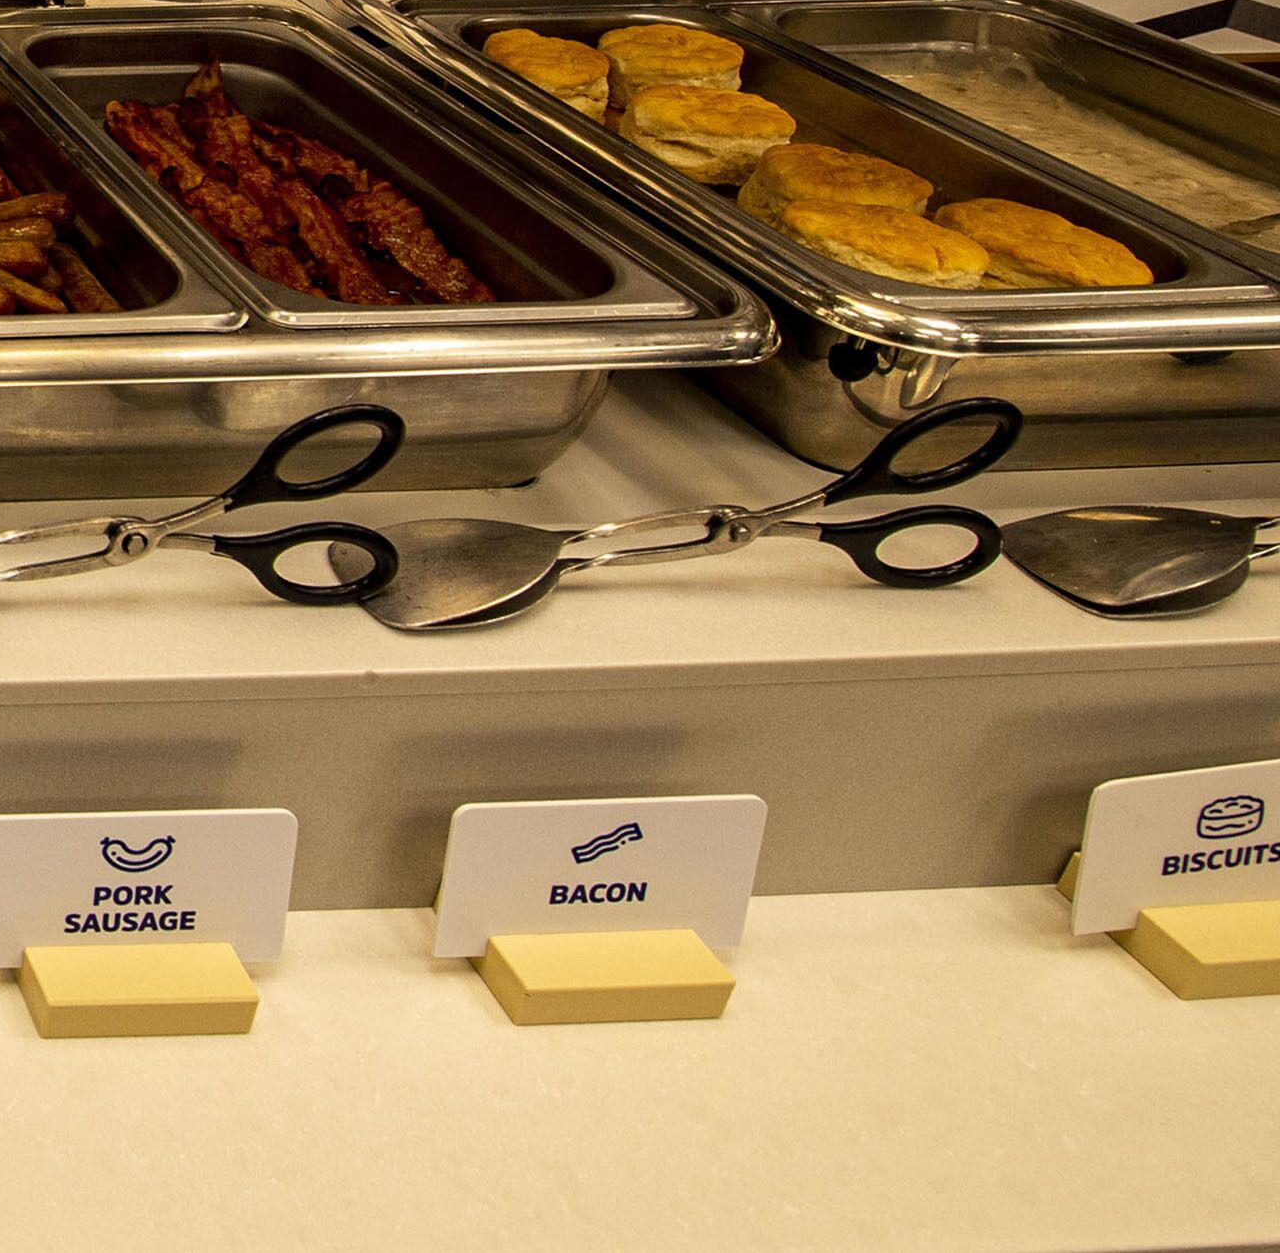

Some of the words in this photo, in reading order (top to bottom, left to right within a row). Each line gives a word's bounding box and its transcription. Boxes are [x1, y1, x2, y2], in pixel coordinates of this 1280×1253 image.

[1161, 842, 1280, 876] BISCUITS
[92, 884, 174, 907] PORK
[548, 882, 648, 905] BACON
[63, 910, 197, 934] SAUSAGE
